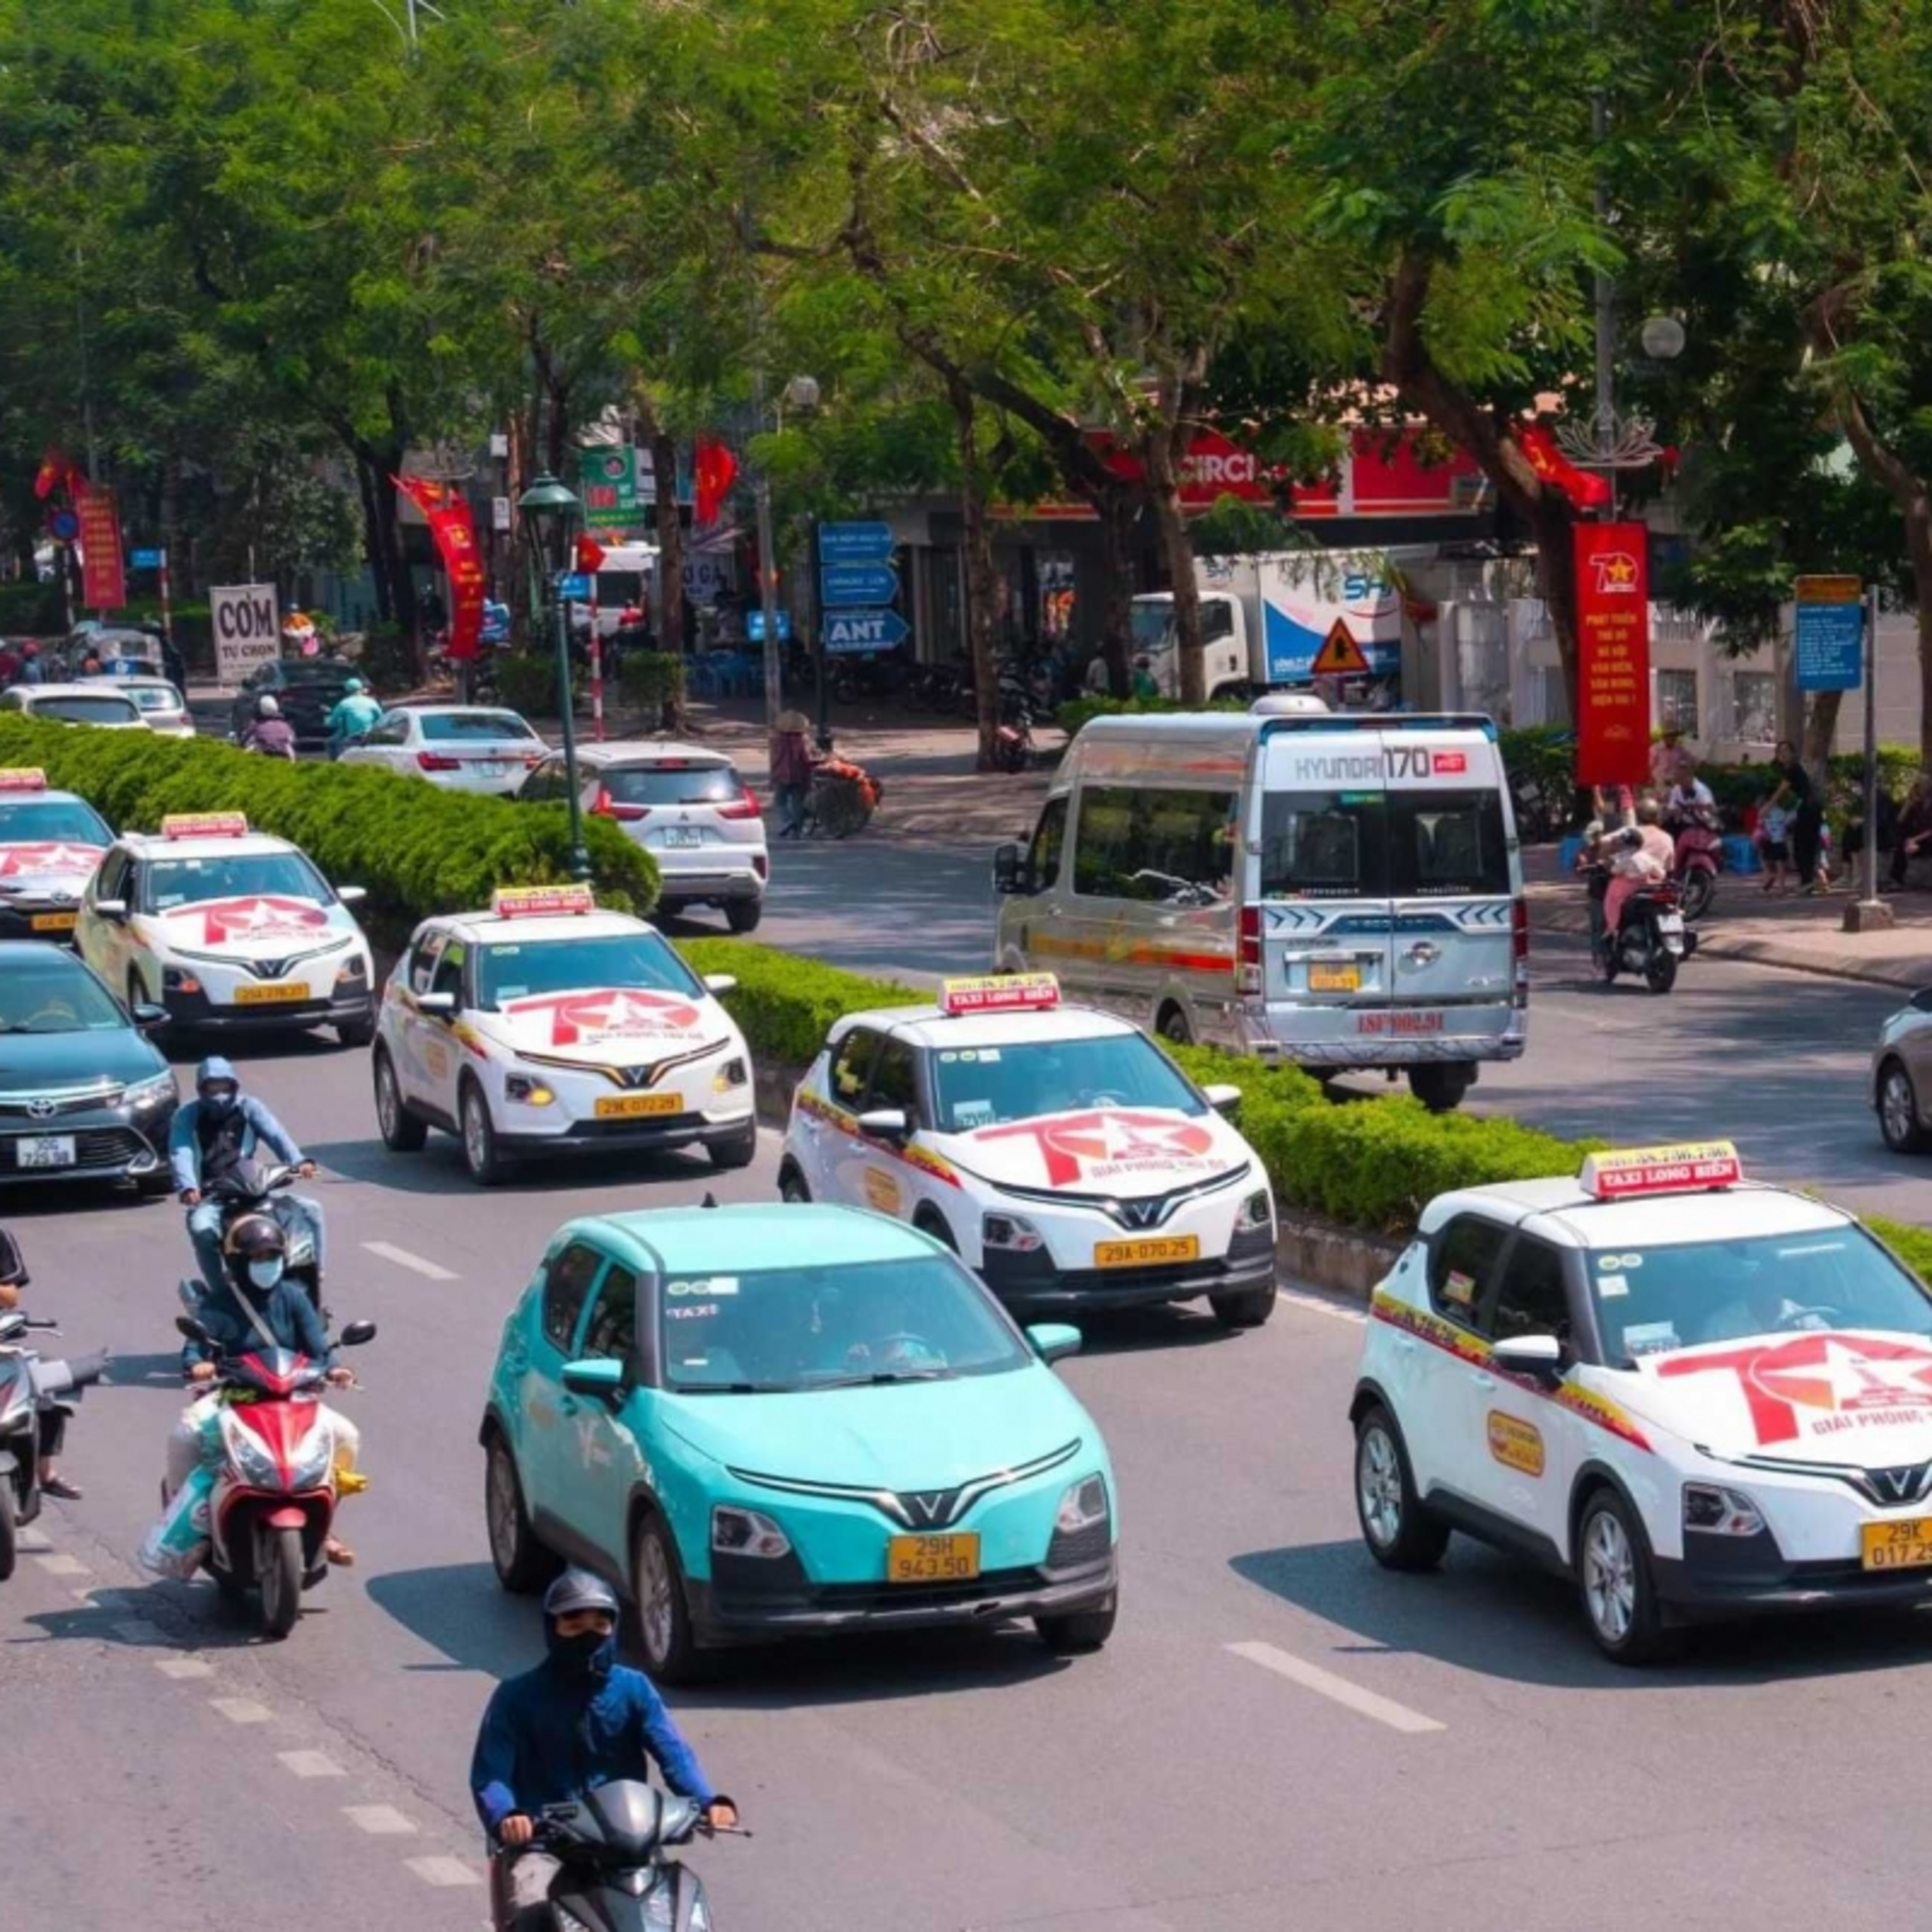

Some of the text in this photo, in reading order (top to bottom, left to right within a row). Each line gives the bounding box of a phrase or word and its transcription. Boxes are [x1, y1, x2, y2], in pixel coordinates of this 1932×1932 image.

[830, 620, 885, 640] ANT
[1383, 746, 1430, 779] 170
[1602, 1170, 1642, 1187] TAXI
[1644, 1166, 1691, 1185] LONG
[1887, 1519, 1924, 1544] 29K
[915, 1535, 954, 1557] 29H
